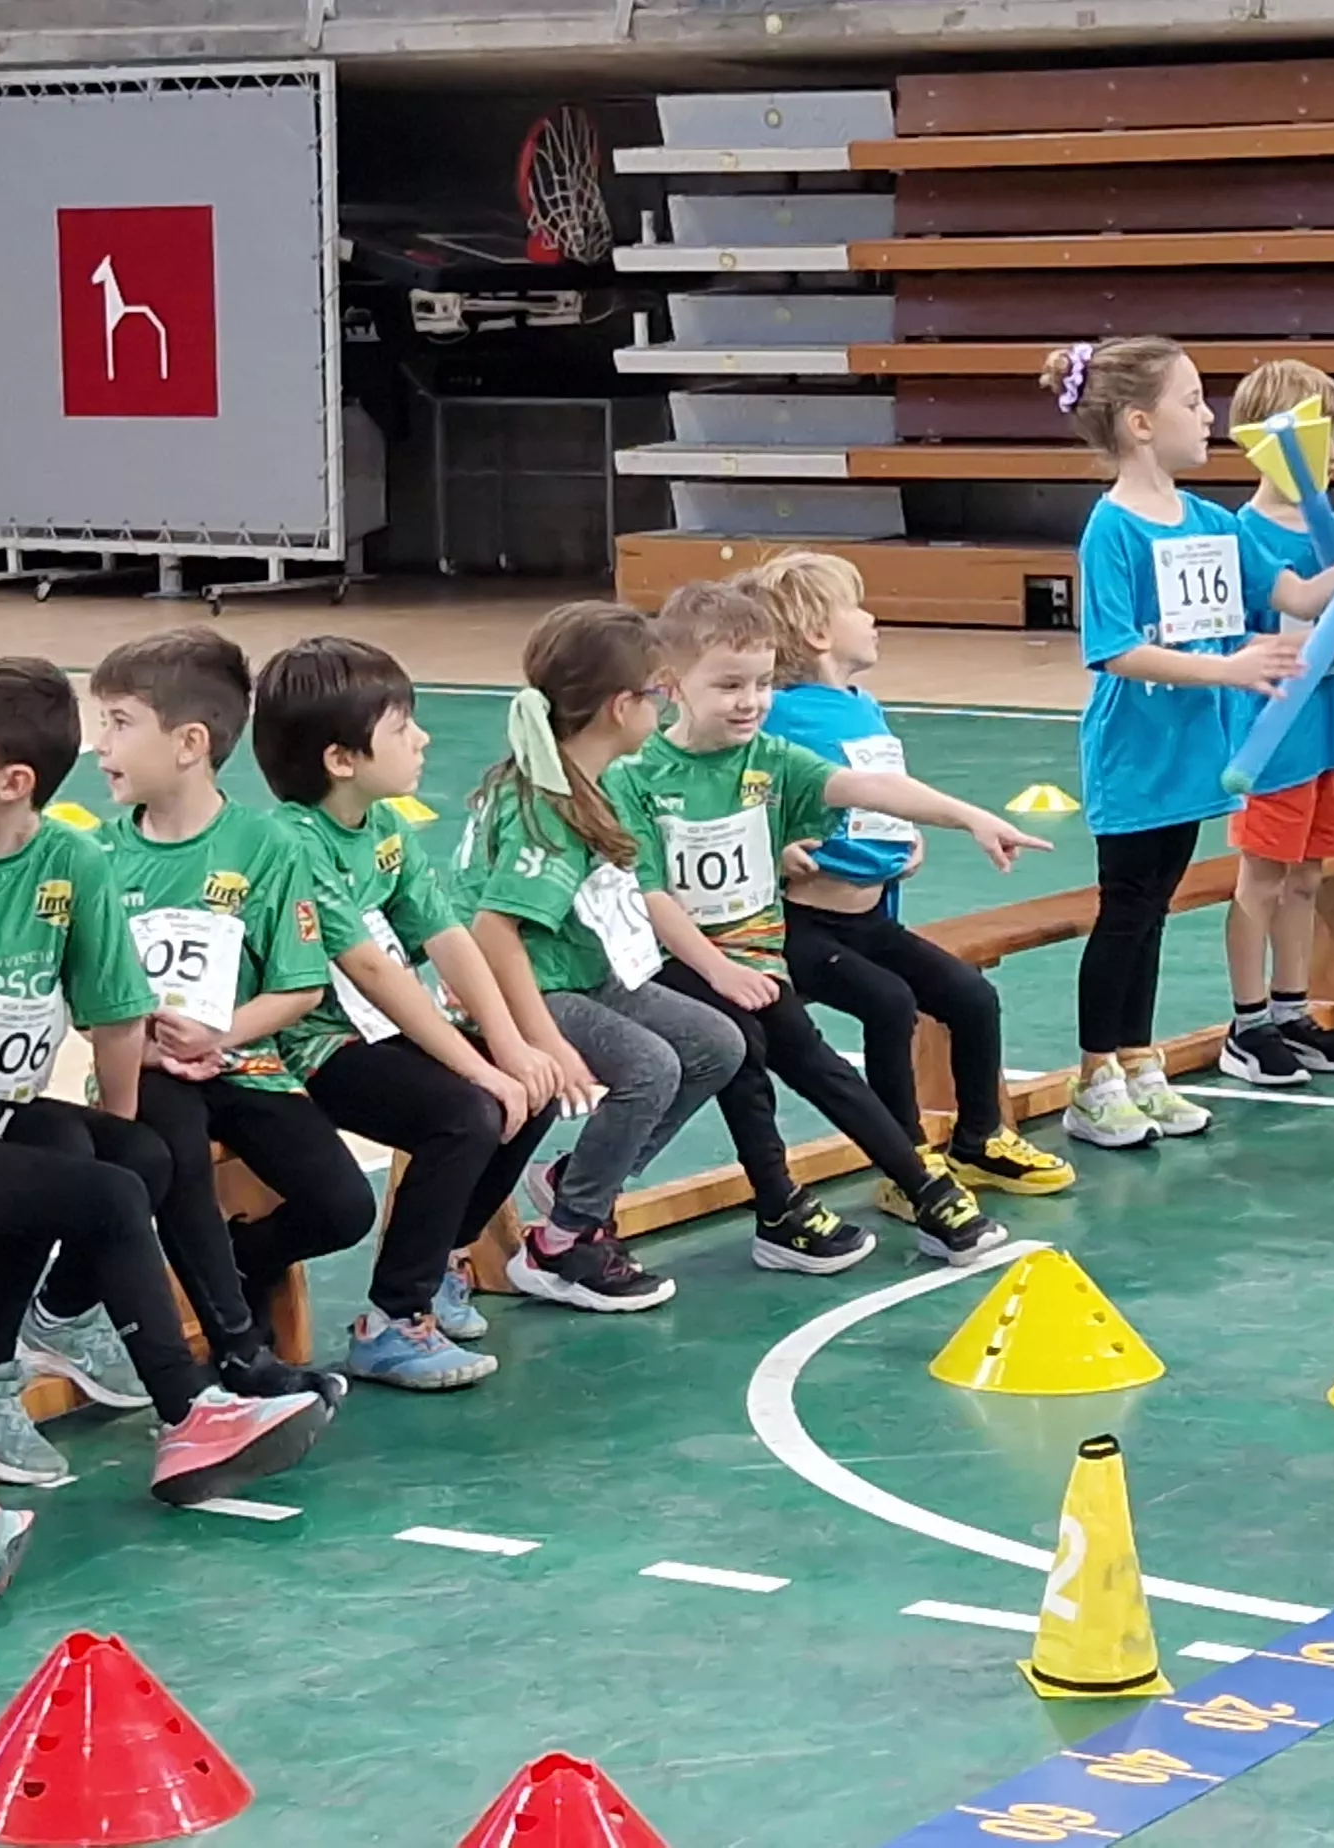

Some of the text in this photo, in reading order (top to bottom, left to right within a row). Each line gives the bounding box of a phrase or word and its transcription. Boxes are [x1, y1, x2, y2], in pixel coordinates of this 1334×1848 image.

[1177, 564, 1229, 606] 116
[674, 844, 750, 890] 101
[1042, 1514, 1088, 1622] 2
[1182, 1694, 1297, 1732] 20
[1085, 1748, 1192, 1784] 40
[978, 1802, 1098, 1843] 60
